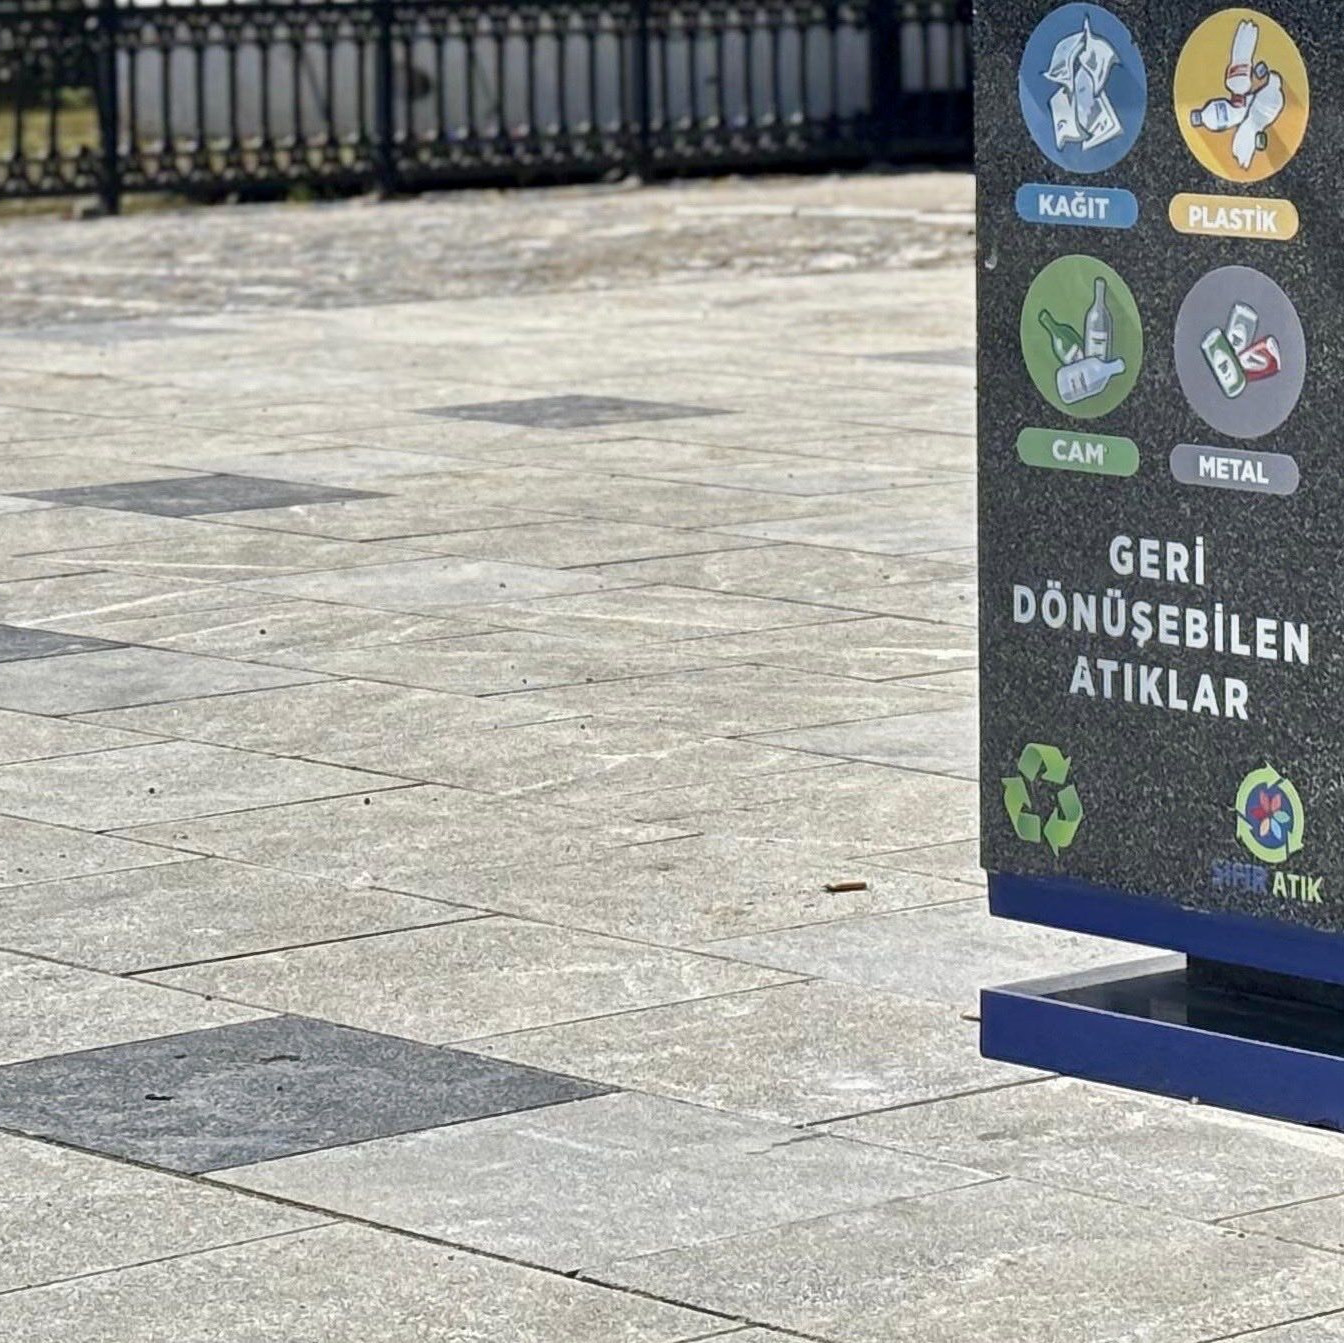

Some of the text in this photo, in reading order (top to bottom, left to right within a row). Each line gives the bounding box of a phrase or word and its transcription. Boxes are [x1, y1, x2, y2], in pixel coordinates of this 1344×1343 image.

[1038, 190, 1110, 220] KAĞIT
[1188, 203, 1278, 234] PLASTİK
[1051, 439, 1105, 467] CAM
[1198, 455, 1269, 486] METAL
[1109, 534, 1205, 586] GERİ
[1012, 579, 1310, 666] DÖNÜŞEBİLEN
[1068, 655, 1250, 721] ATIKLAR
[1272, 870, 1324, 904] ATIK
